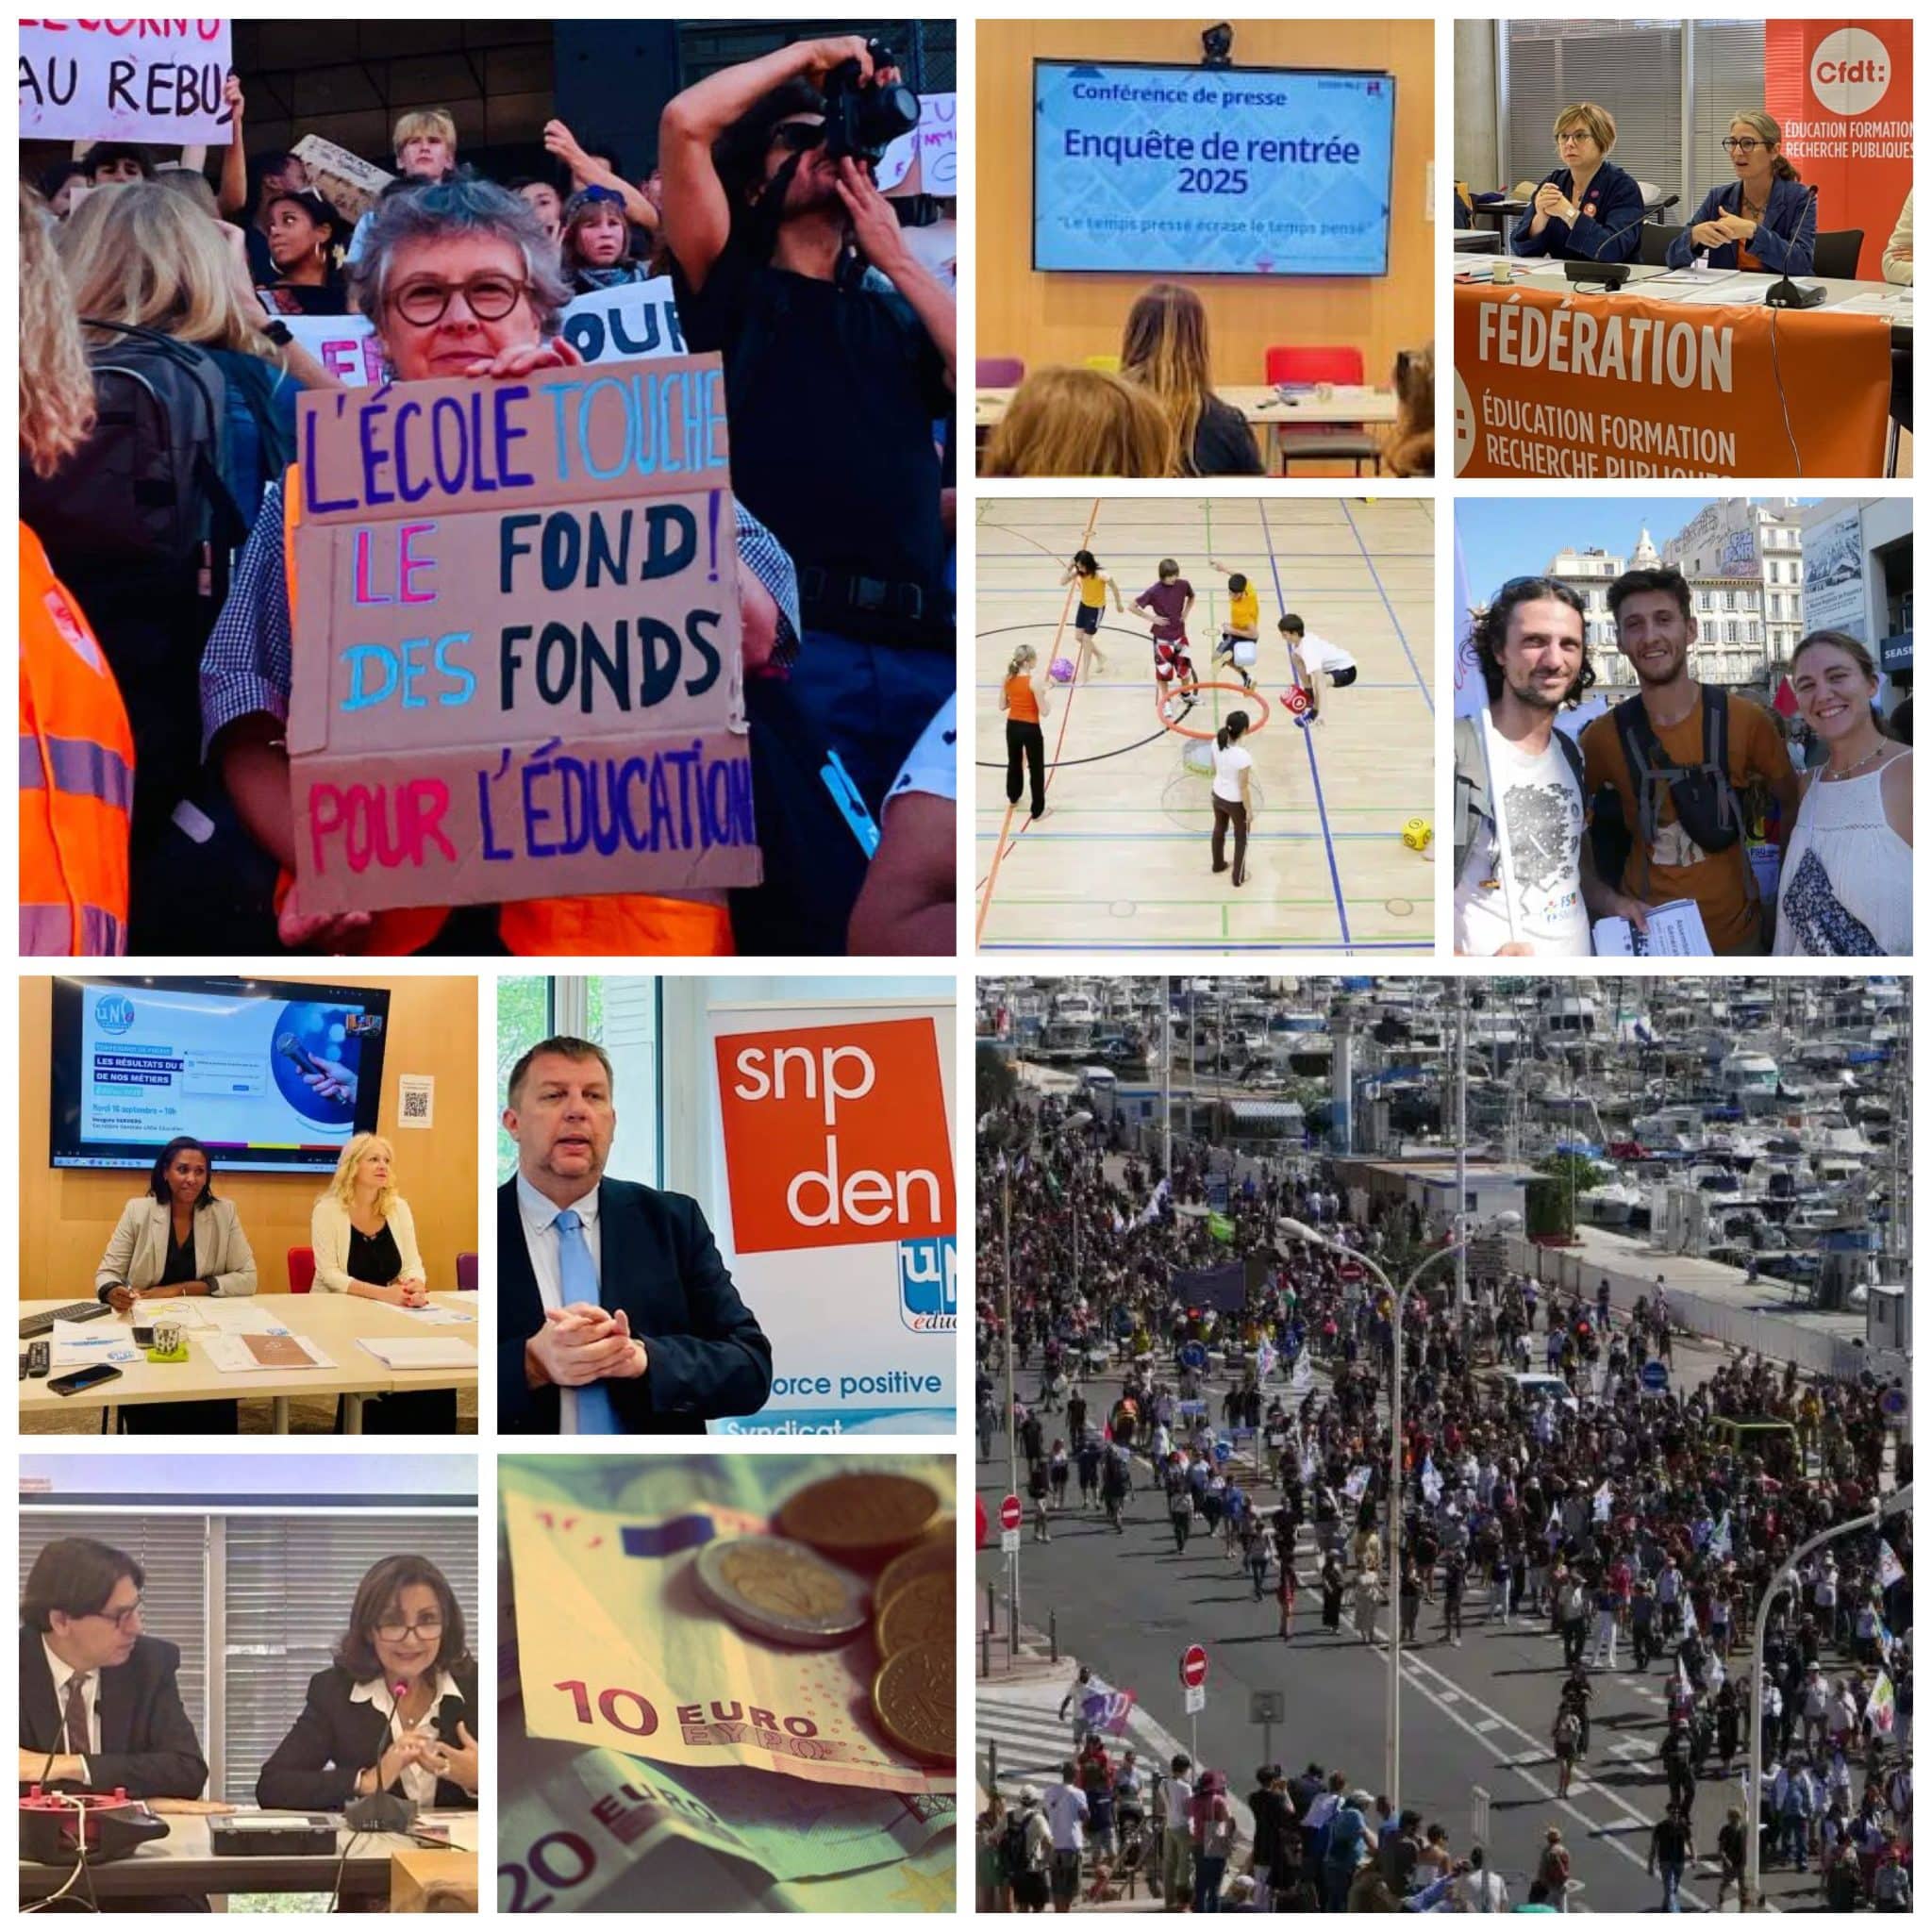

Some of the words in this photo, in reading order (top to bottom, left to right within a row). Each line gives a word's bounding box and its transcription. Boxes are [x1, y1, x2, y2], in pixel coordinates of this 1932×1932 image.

[19, 56, 76, 106] AU
[1073, 83, 1188, 103] Conférence
[1192, 87, 1217, 104] de
[1222, 90, 1287, 108] presse
[1816, 59, 1885, 84] Cfdt:
[1064, 128, 1194, 165] Enquête
[1201, 133, 1240, 161] de
[1246, 137, 1360, 164] rentrée
[1785, 120, 1847, 138] ÉDUCATION
[1850, 122, 1913, 139] FORMATIO
[1786, 142, 1848, 158] RECHERCHE
[1178, 168, 1248, 194] 2025
[1478, 293, 1734, 393] FÉDÉRATION
[307, 381, 535, 514] L'ÉCOLE
[539, 369, 728, 482] TOUCHE
[1482, 388, 1594, 444] ÉDUCATION
[1600, 413, 1736, 467] FORMATION
[1486, 433, 1598, 478] RECHERCHE
[354, 523, 440, 606] LE
[339, 630, 477, 711] DES
[500, 609, 722, 713] FONDS
[308, 779, 458, 874] POUR
[477, 737, 754, 861] L'ÉDUCATION
[97, 1057, 113, 1065] LES
[115, 1058, 163, 1069] RÉSULTATS
[131, 1074, 169, 1084] MÉTIERS
[734, 1045, 875, 1125] snp
[787, 1135, 941, 1226] den
[773, 1376, 831, 1394] orce
[841, 1371, 941, 1398] positive
[553, 1679, 659, 1737] 10
[676, 1701, 818, 1738] EURO
[497, 1831, 597, 1913] 20
